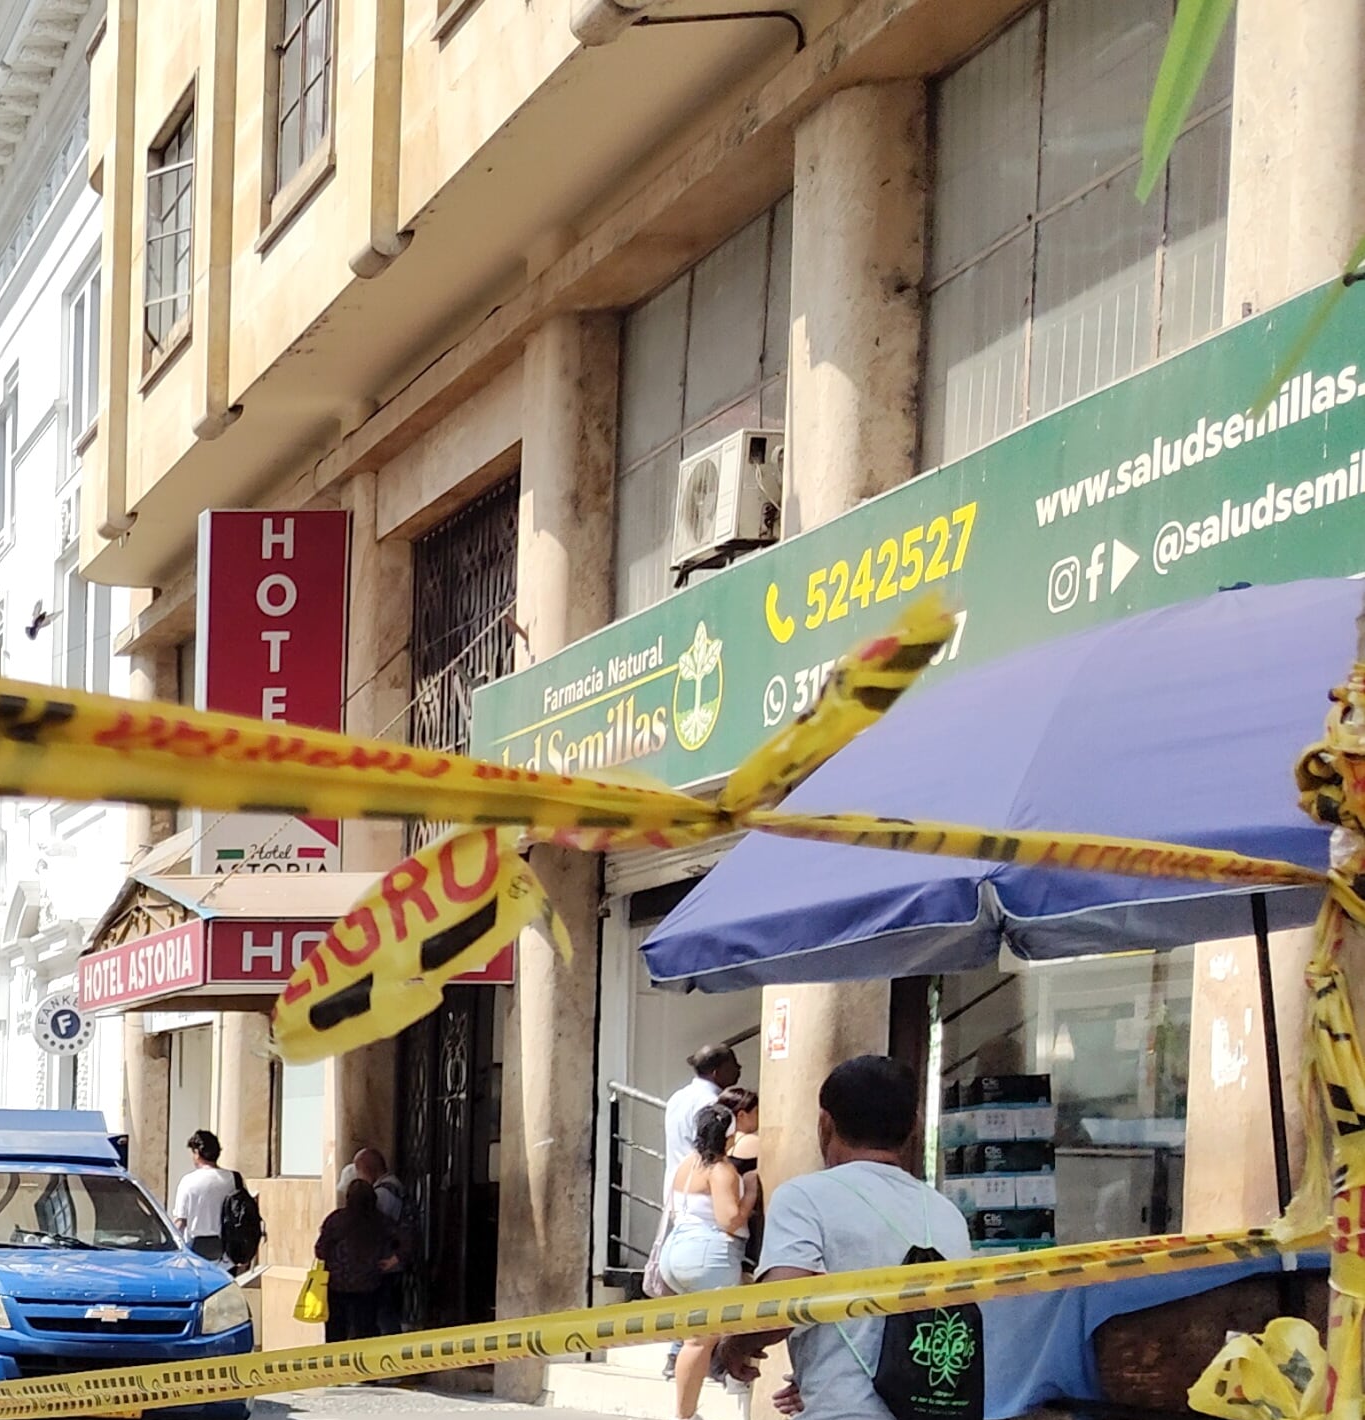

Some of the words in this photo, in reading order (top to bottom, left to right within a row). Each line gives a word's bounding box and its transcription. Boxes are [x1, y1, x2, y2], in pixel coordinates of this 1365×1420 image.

[805, 501, 977, 629] 5242527
[543, 666, 603, 714] Farmacia
[607, 635, 663, 688] Natural
[547, 693, 667, 775] Semillas
[83, 953, 124, 1001] HOTEL
[127, 932, 193, 986] ASTORIA
